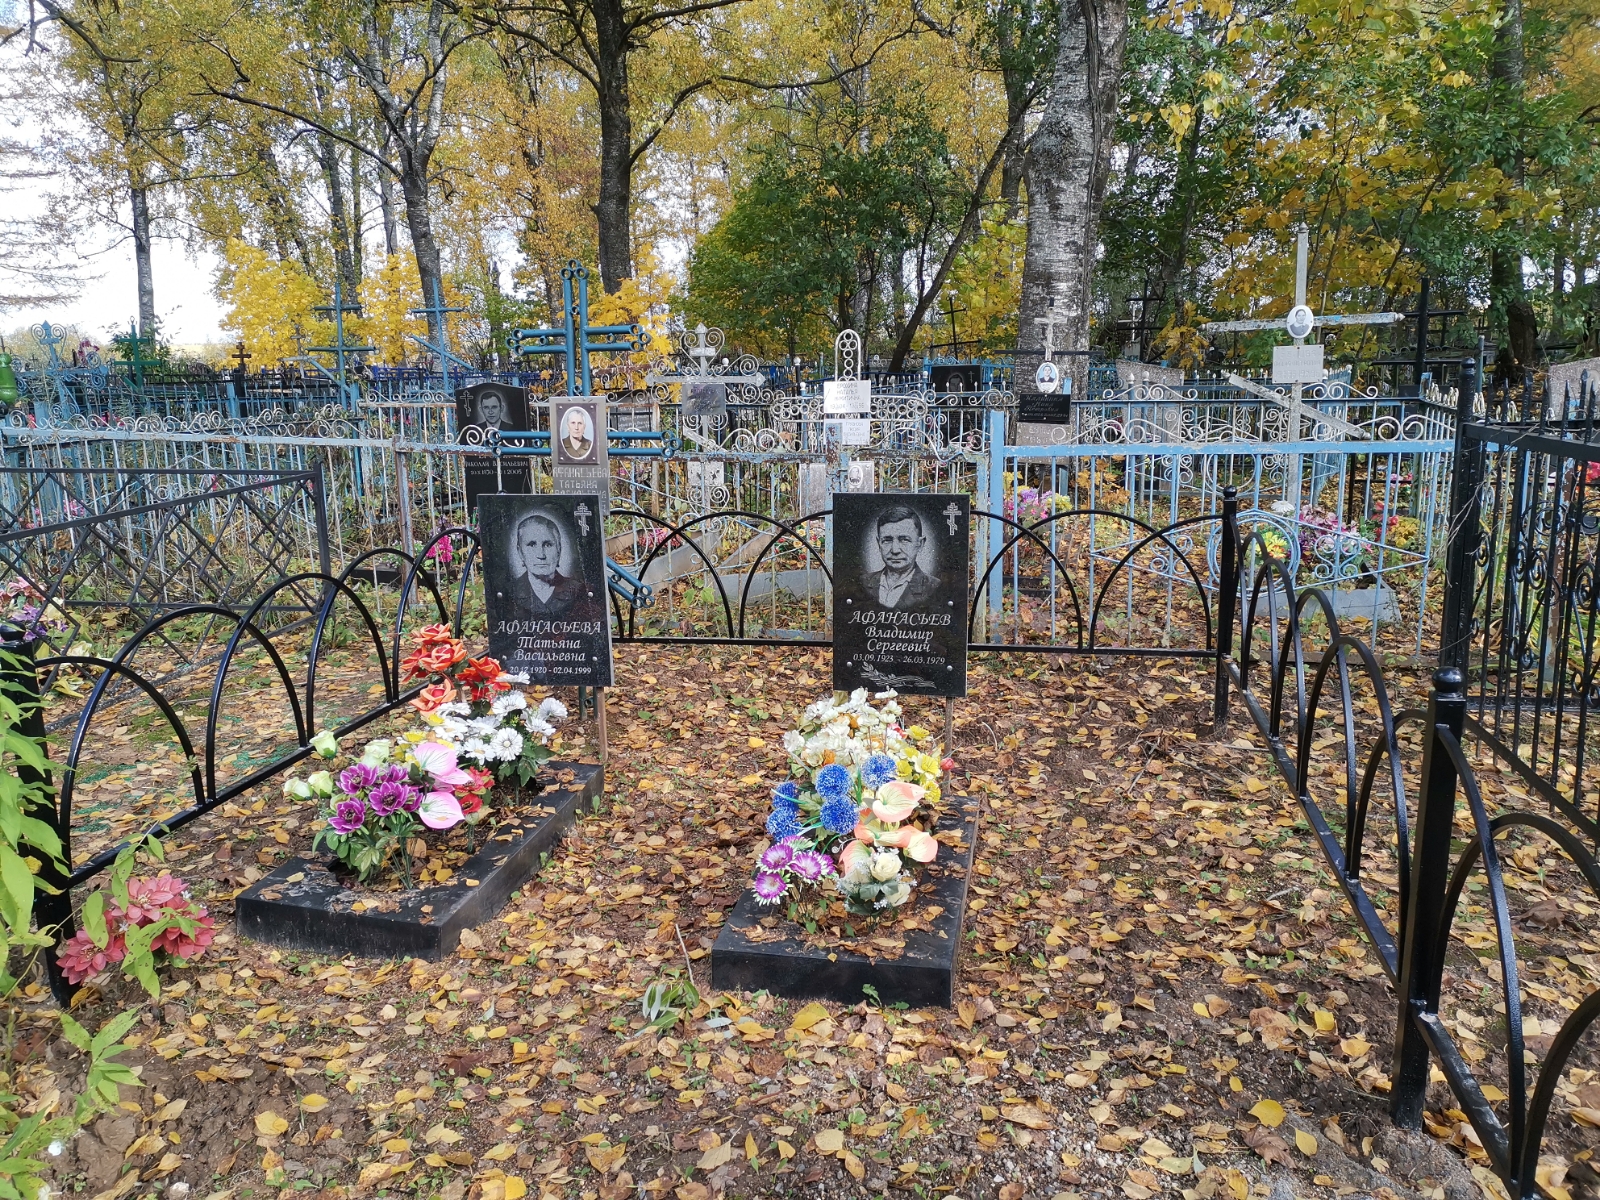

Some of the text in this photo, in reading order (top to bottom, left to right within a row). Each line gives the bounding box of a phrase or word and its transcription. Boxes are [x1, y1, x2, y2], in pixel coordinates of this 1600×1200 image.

[559, 479, 598, 489] ТАТЬЯНА
[848, 610, 952, 626] АФАНАСЬЕВ
[494, 620, 602, 635] АФАНАСЬЕВА
[865, 625, 934, 643] Владимир
[517, 636, 582, 649] Татьяна
[867, 638, 931, 654] Сергеевич
[514, 648, 586, 662] Васильевна
[902, 655, 946, 665] 26.03.1979
[553, 666, 592, 674] 02.04.1999
